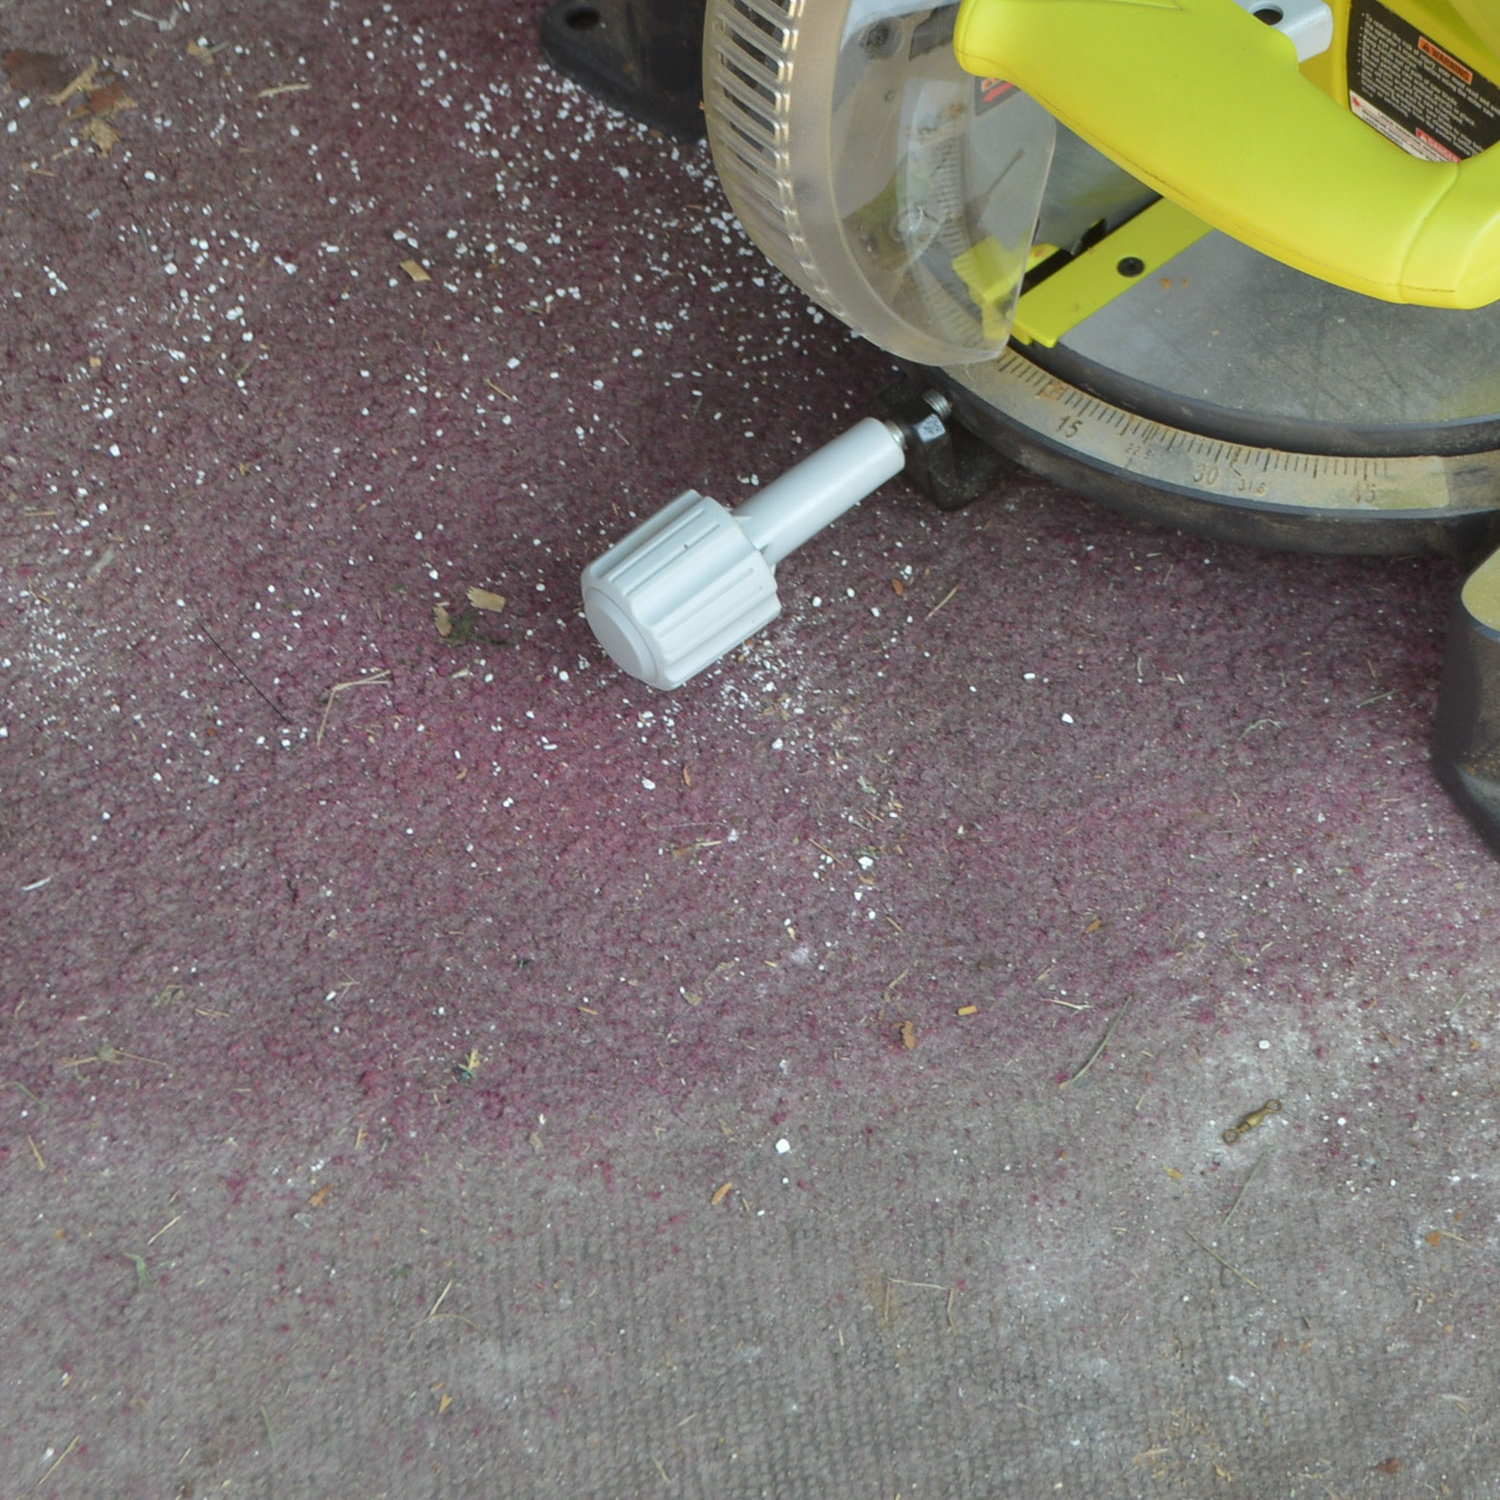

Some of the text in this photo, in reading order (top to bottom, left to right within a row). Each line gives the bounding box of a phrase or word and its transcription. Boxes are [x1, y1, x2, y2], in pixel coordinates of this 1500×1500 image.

[1432, 46, 1469, 81] WARNING
[1056, 415, 1083, 438] 15
[1193, 463, 1220, 486] 30
